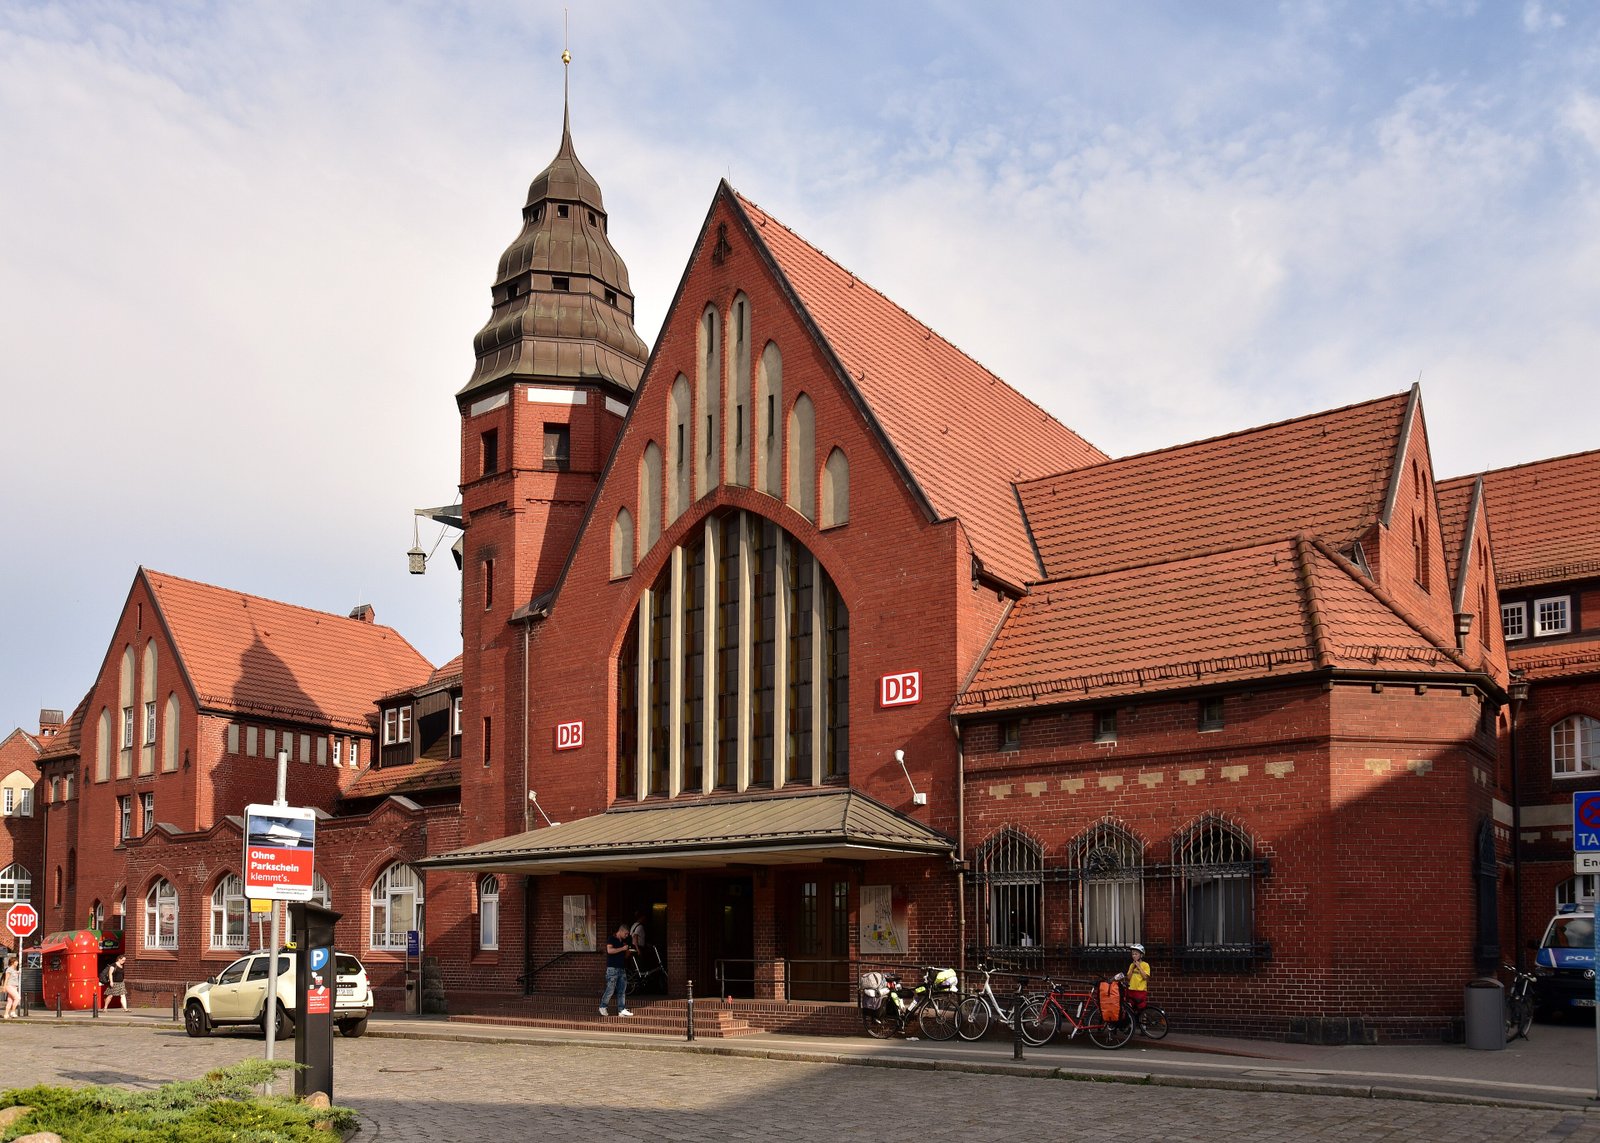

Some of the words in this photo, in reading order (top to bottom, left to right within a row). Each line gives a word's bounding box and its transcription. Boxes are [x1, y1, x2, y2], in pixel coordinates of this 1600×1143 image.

[886, 675, 916, 701] DB
[560, 724, 580, 745] DB
[251, 851, 276, 860] Ohne
[251, 861, 299, 873] Parkschein
[1583, 859, 1600, 867] En
[250, 873, 290, 882] klemmt's.
[10, 913, 35, 927] STOP
[313, 950, 324, 967] P
